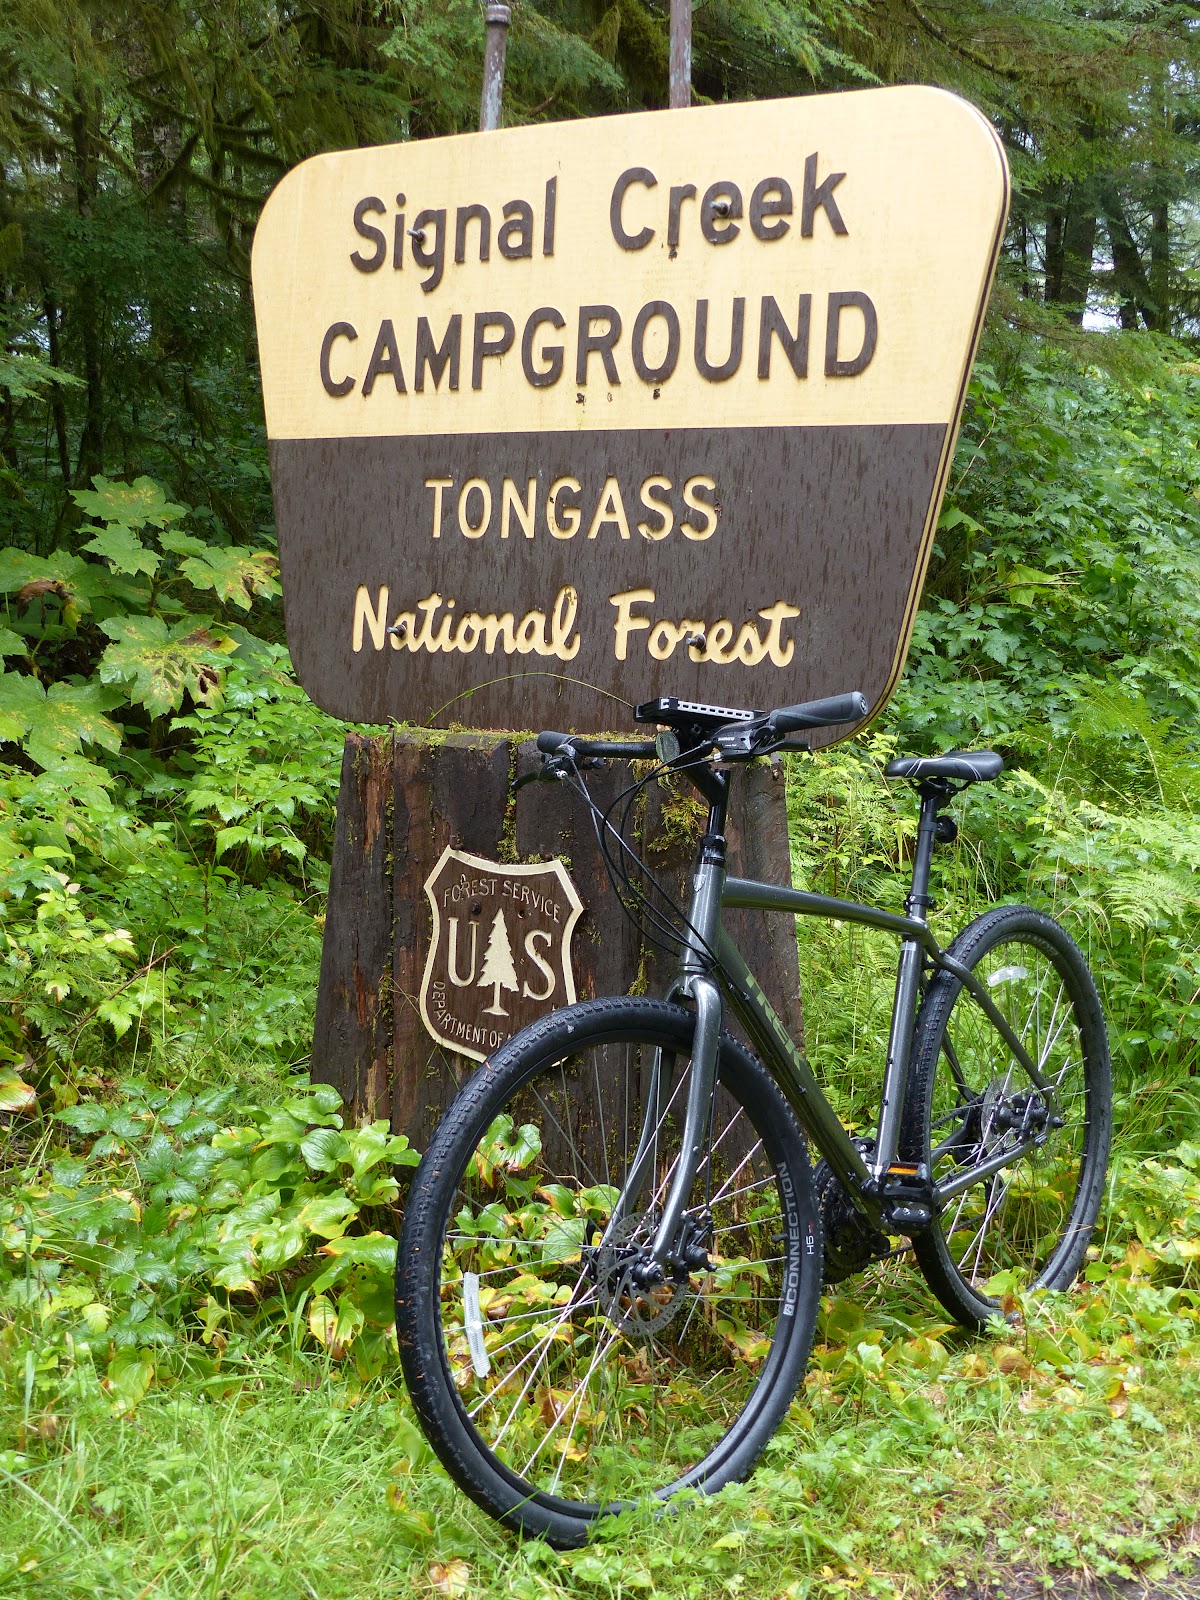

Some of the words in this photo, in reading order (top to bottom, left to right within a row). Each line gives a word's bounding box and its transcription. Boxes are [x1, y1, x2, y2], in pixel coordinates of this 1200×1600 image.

[350, 175, 557, 293] Signal
[610, 151, 848, 251] Creek
[320, 290, 878, 398] CAMPGROUND
[424, 475, 719, 541] TONGASS
[352, 584, 581, 661] National
[610, 587, 801, 668] Forest
[443, 878, 498, 907] FOREST
[502, 879, 560, 923] SERVICE
[432, 981, 487, 1045] DEPARTMENT
[489, 1031, 503, 1048] OF
[776, 1161, 800, 1302] CONNECTION
